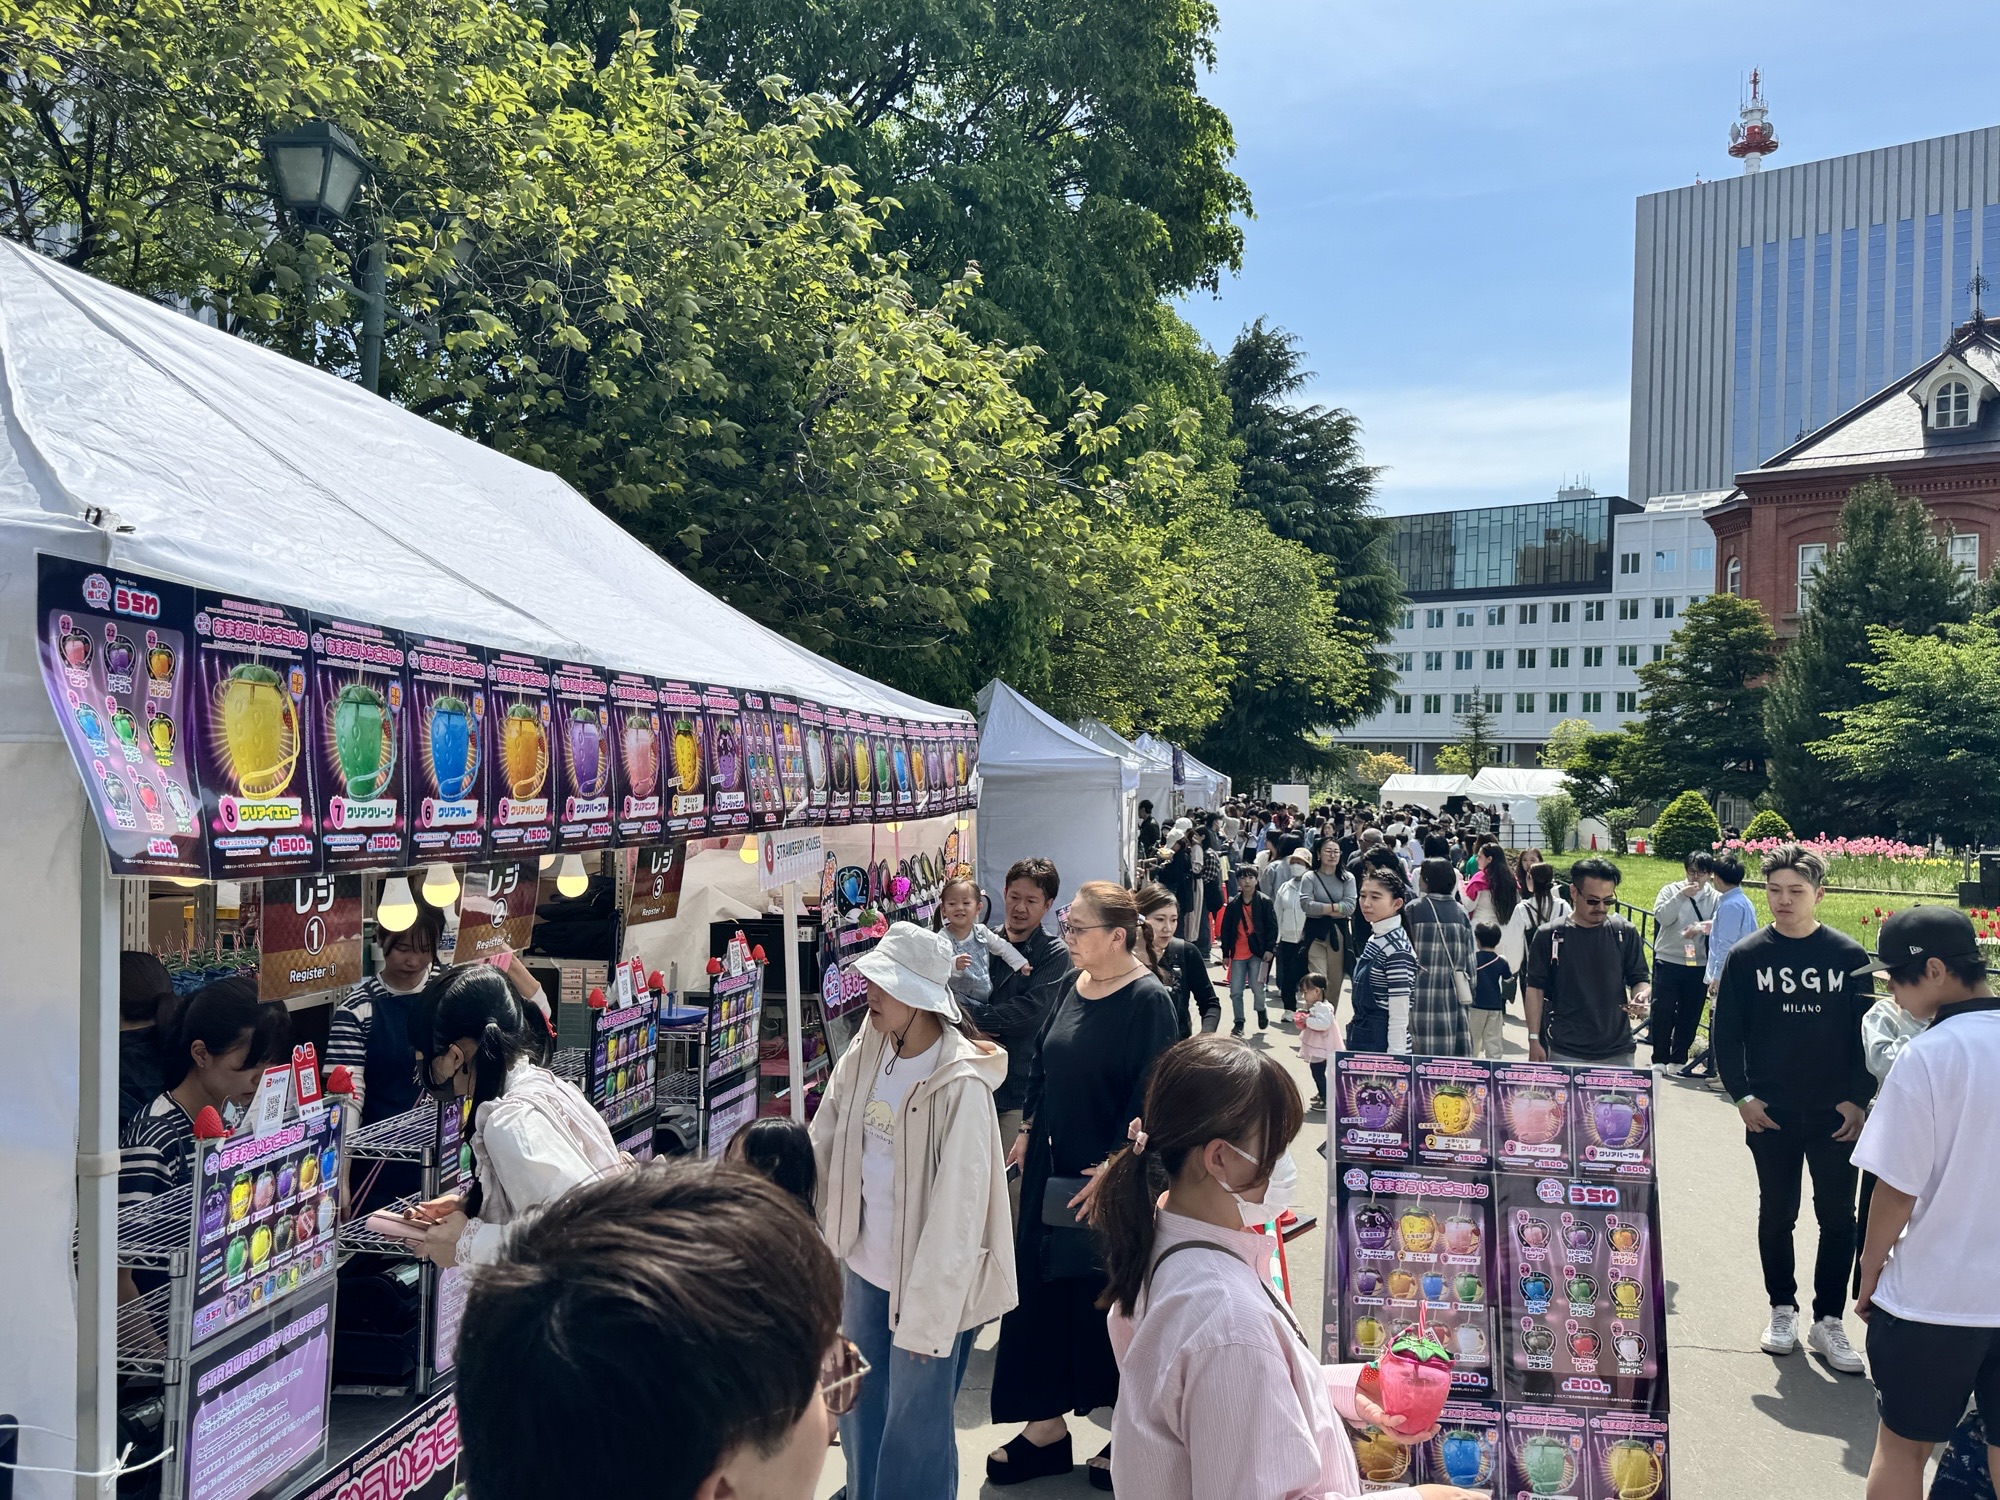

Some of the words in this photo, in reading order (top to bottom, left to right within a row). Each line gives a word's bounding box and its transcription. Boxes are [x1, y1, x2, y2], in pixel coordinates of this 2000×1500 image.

[90, 580, 104, 590] 私の
[116, 577, 128, 586] Paper
[87, 590, 108, 600] 推し色
[115, 587, 159, 618] うちわ
[61, 620, 70, 630] 21
[106, 628, 116, 638] 22
[214, 618, 308, 648] あまおういちごミルク
[148, 636, 156, 644] 23
[326, 638, 404, 666] あまおういちごミルク
[420, 654, 486, 678] あまおういちごミルク
[70, 676, 87, 687] ピンク
[108, 683, 132, 694] パープル
[150, 688, 172, 698] オレンジ
[108, 701, 116, 710] 25
[146, 705, 156, 715] 26
[502, 806, 508, 818] 5
[510, 805, 544, 816] クリアオレンジ
[568, 802, 574, 814] 4
[576, 802, 606, 814] クリアパープル
[626, 801, 631, 813] 3
[634, 802, 656, 811] クリアピンク
[673, 800, 678, 811] 2
[684, 804, 698, 812] ゴールド
[226, 805, 234, 822] 8
[240, 805, 298, 820] クリアイエロー
[334, 804, 342, 822] 7
[347, 807, 394, 819] クリアグリーン
[425, 805, 431, 820] 6
[438, 807, 472, 818] クリアブルー
[270, 837, 312, 854] 各1500円
[367, 836, 400, 850] 各1500円
[776, 840, 804, 860] STRAWBERRY
[806, 835, 820, 852] HOUSES
[651, 848, 674, 874] レジ
[487, 863, 520, 898] レジ
[296, 874, 335, 914] レジ
[642, 907, 660, 916] Register
[476, 937, 504, 950] Register
[507, 934, 512, 942] 2
[290, 966, 326, 982] Register
[1756, 966, 1844, 994] MSGM
[1782, 1003, 1821, 1012] MILANO
[1350, 1132, 1356, 1141] 1
[1428, 1138, 1434, 1146] 2
[220, 1123, 306, 1170] あまおういちごミルク
[1508, 1142, 1514, 1152] 3
[1521, 1146, 1556, 1154] クリアピンク
[1376, 1149, 1408, 1158] 各1500円
[1456, 1154, 1487, 1163] 各1500円
[1589, 1150, 1595, 1158] 4
[1370, 1178, 1488, 1198] あまおういちごミルク
[1570, 1186, 1618, 1204] うちわ
[198, 1330, 282, 1396] STRAWBERRY
[282, 1303, 328, 1346] HOUSES
[1450, 1372, 1488, 1384] 500円
[1562, 1379, 1610, 1392] 各200円
[318, 1468, 350, 1499] HOUSES
